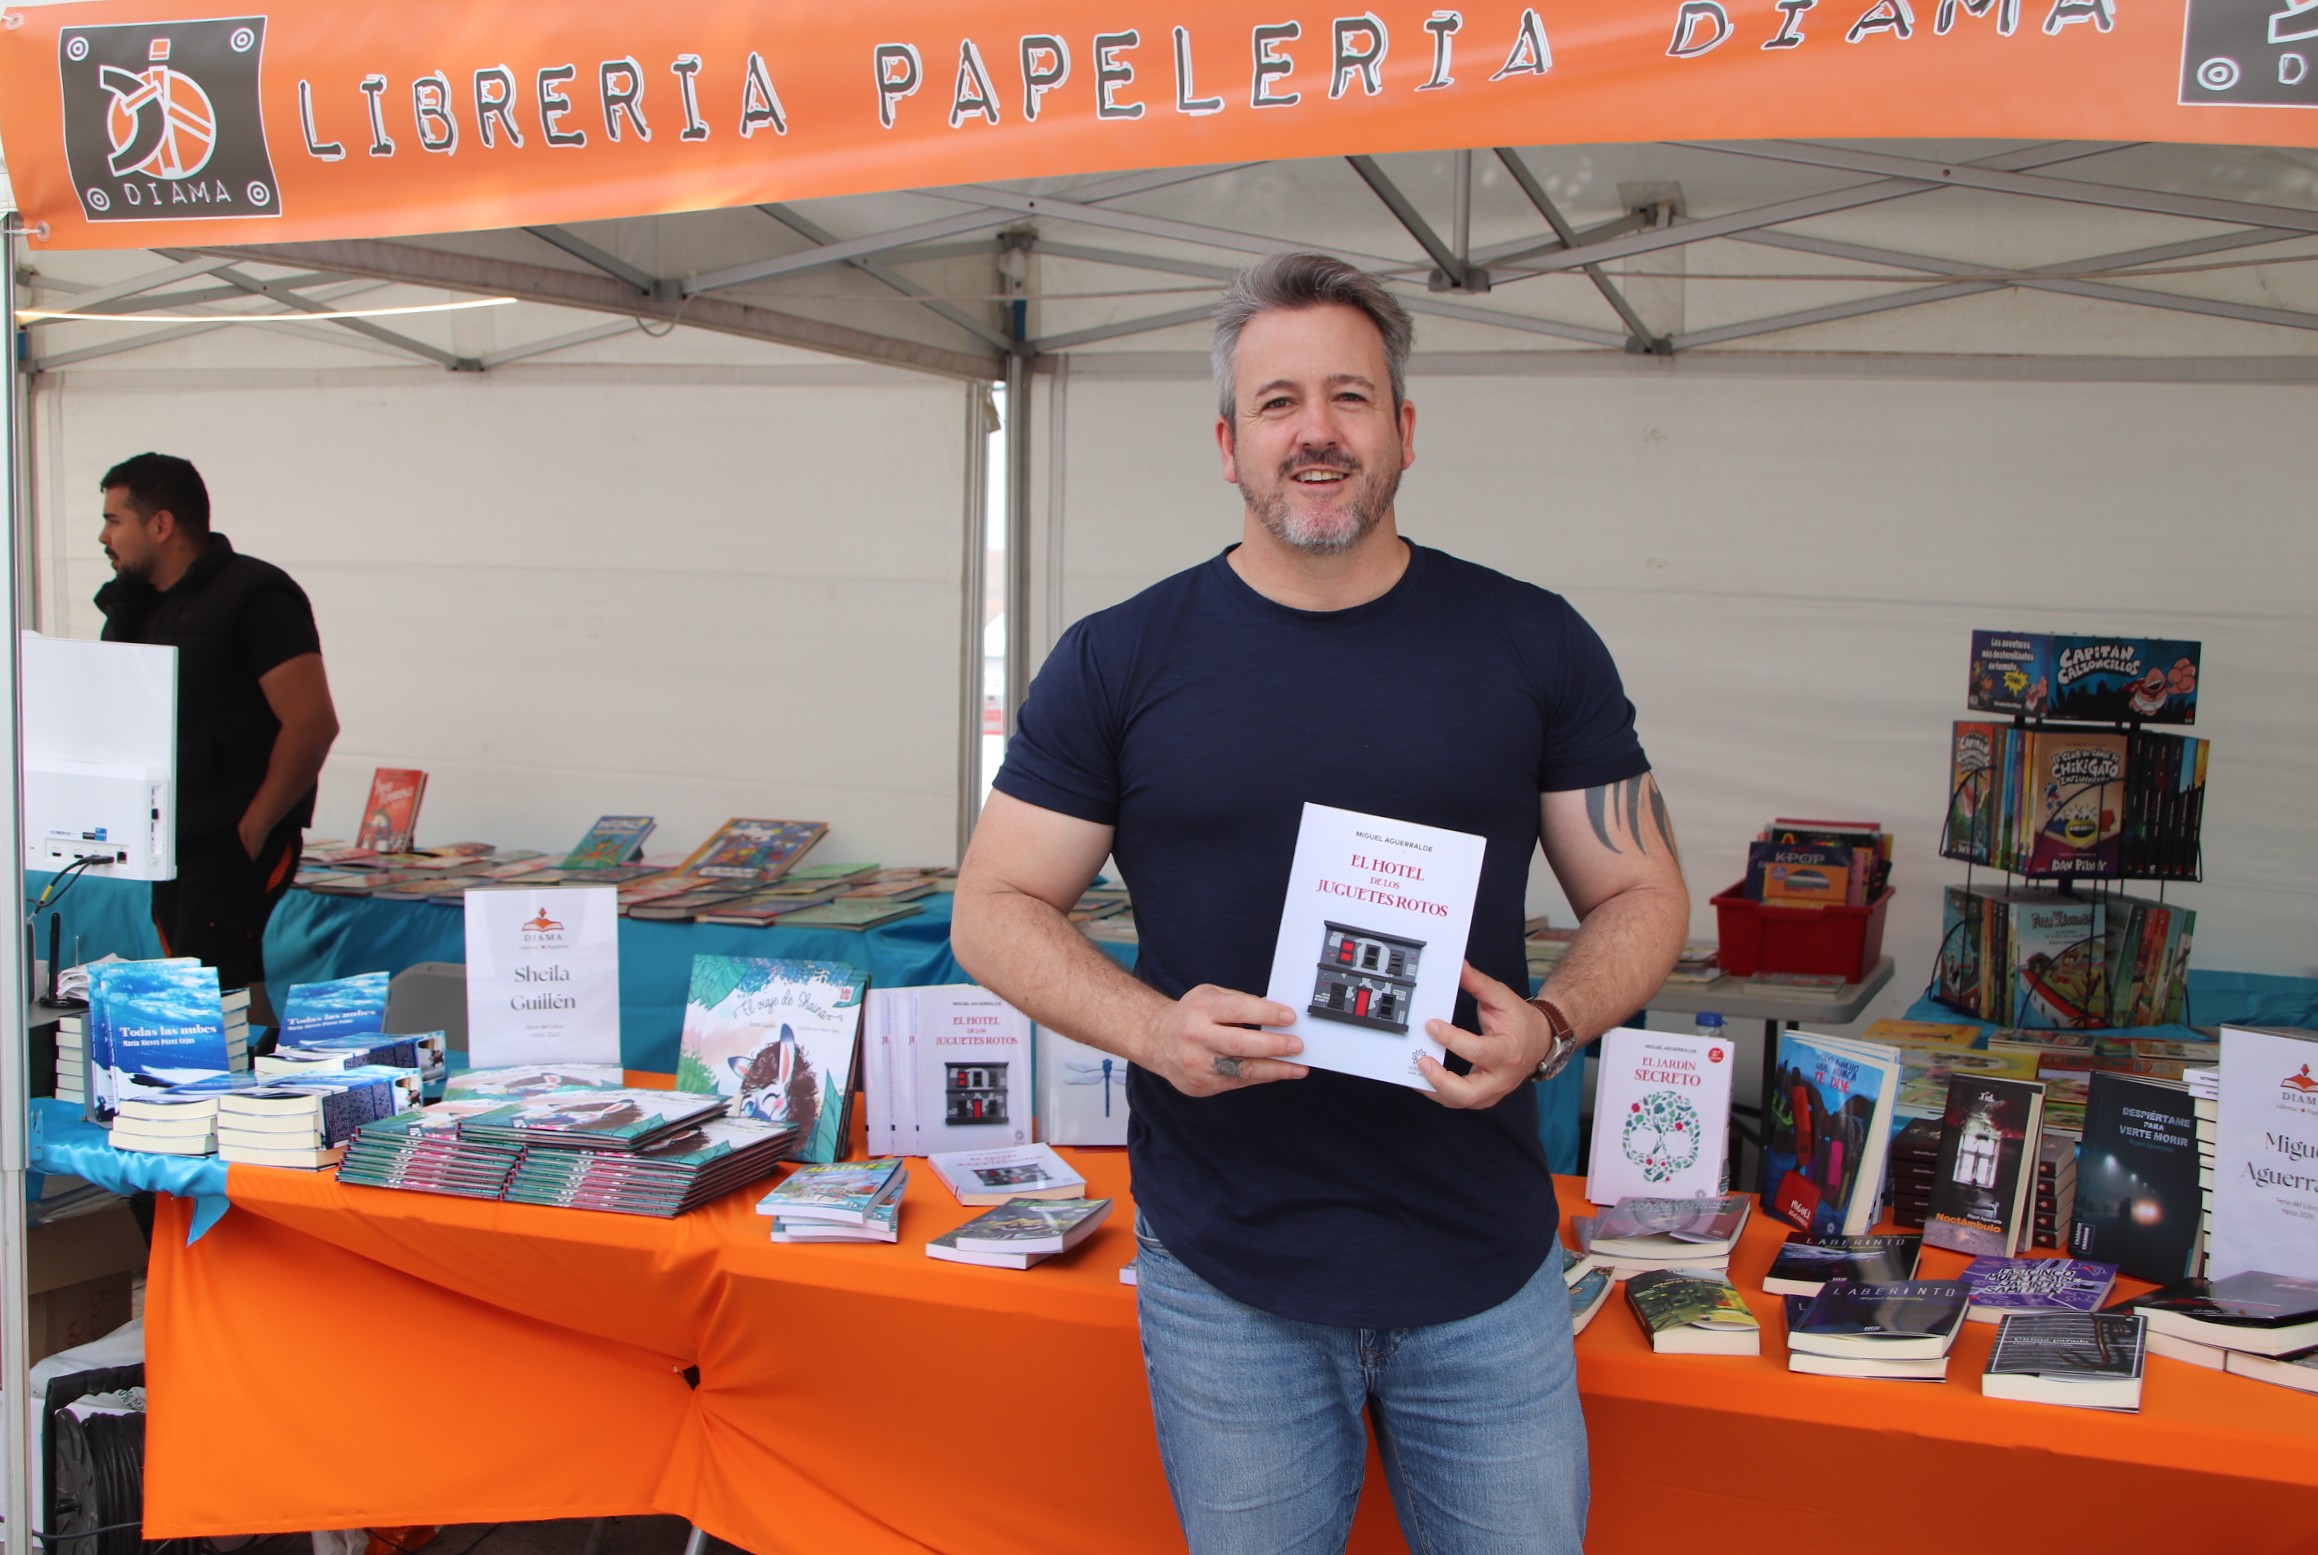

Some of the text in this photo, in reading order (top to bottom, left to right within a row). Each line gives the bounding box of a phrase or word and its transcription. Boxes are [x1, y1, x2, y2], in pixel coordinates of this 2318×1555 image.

[299, 8, 1553, 161] LIBRERIA PAPELERIA
[123, 180, 232, 205] DIAMA
[2057, 660, 2140, 685] CALZONCILLOS
[1355, 831, 1433, 853] MIGUEL AGUERRALDE
[1350, 854, 1425, 881] EL HOTEL
[1370, 876, 1400, 889] DE LOS
[1315, 879, 1449, 918] JUGUETES ROTOS
[524, 934, 563, 942] DIAMA
[514, 965, 570, 983] Sheila
[510, 993, 576, 1011] Guillén
[288, 1015, 322, 1025] Todas
[342, 1009, 376, 1018] nubes
[953, 1016, 1000, 1025] EL HOTEL
[120, 1024, 217, 1037] Todas las nubes
[936, 1036, 1018, 1046] JUGUETES ROTOS
[1642, 1057, 1697, 1070] EL JARDÍN
[1634, 1069, 1701, 1087] SECRETO
[2122, 1106, 2191, 1128] DESPIÉRTAME
[2143, 1121, 2164, 1131] PARA
[2119, 1125, 2188, 1147] VERTE MORIR
[2265, 1132, 2318, 1162] Migu
[2241, 1161, 2318, 1193] Aguerr
[2276, 1197, 2291, 1206] Feria
[2292, 1200, 2302, 1208] del
[1936, 1212, 2002, 1233] Noctámbulo
[1806, 1237, 1905, 1246] LABERINTO
[1834, 1287, 1956, 1297] LABERINTO
